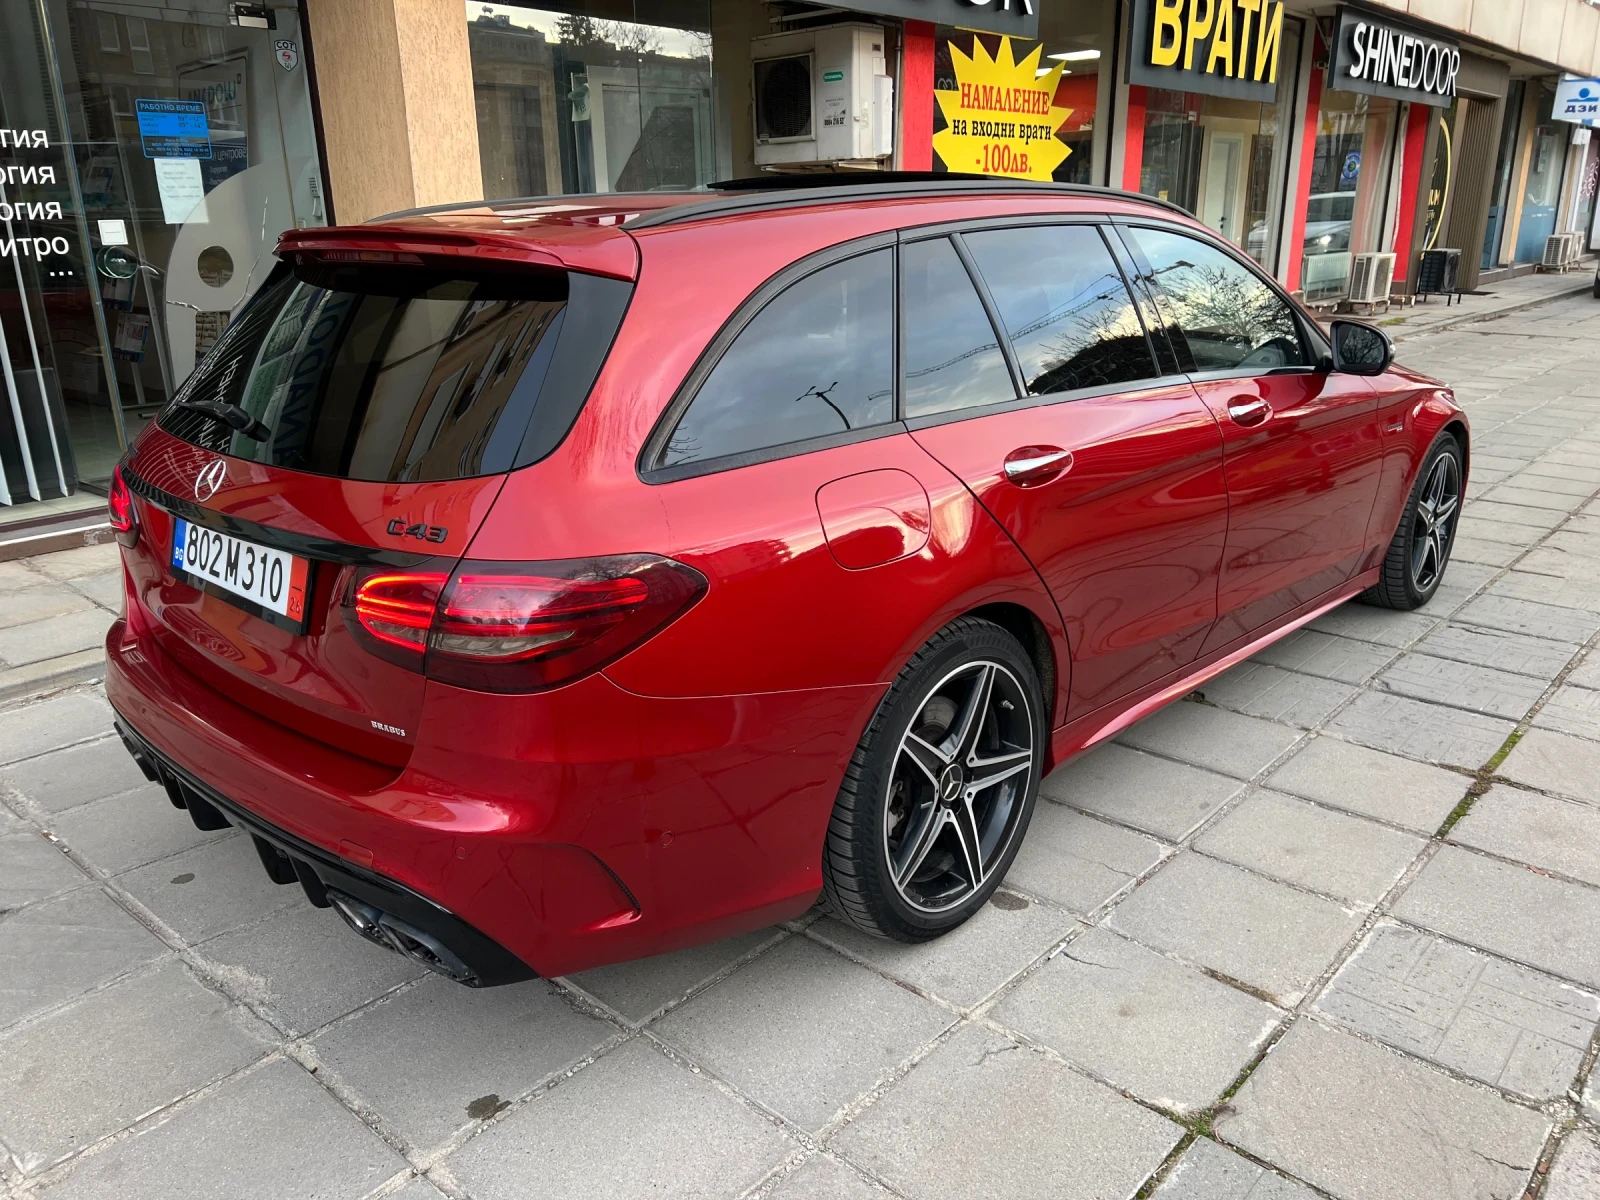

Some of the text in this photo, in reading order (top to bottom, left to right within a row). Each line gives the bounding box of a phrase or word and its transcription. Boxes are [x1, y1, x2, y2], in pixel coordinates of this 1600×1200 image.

[1151, 0, 1284, 84] ВРАТИ
[1349, 21, 1460, 97] SHINEDOOR
[140, 103, 200, 112] РАБОТНО ВРЕМЕ
[960, 82, 1050, 116] НАМАЛЕНИЕ
[1564, 104, 1598, 113] ДЗИ
[952, 119, 1051, 145] на входни врати
[975, 143, 1032, 173] -100лв.
[386, 518, 449, 544] C43
[174, 546, 184, 561] BG
[289, 597, 301, 614] 26
